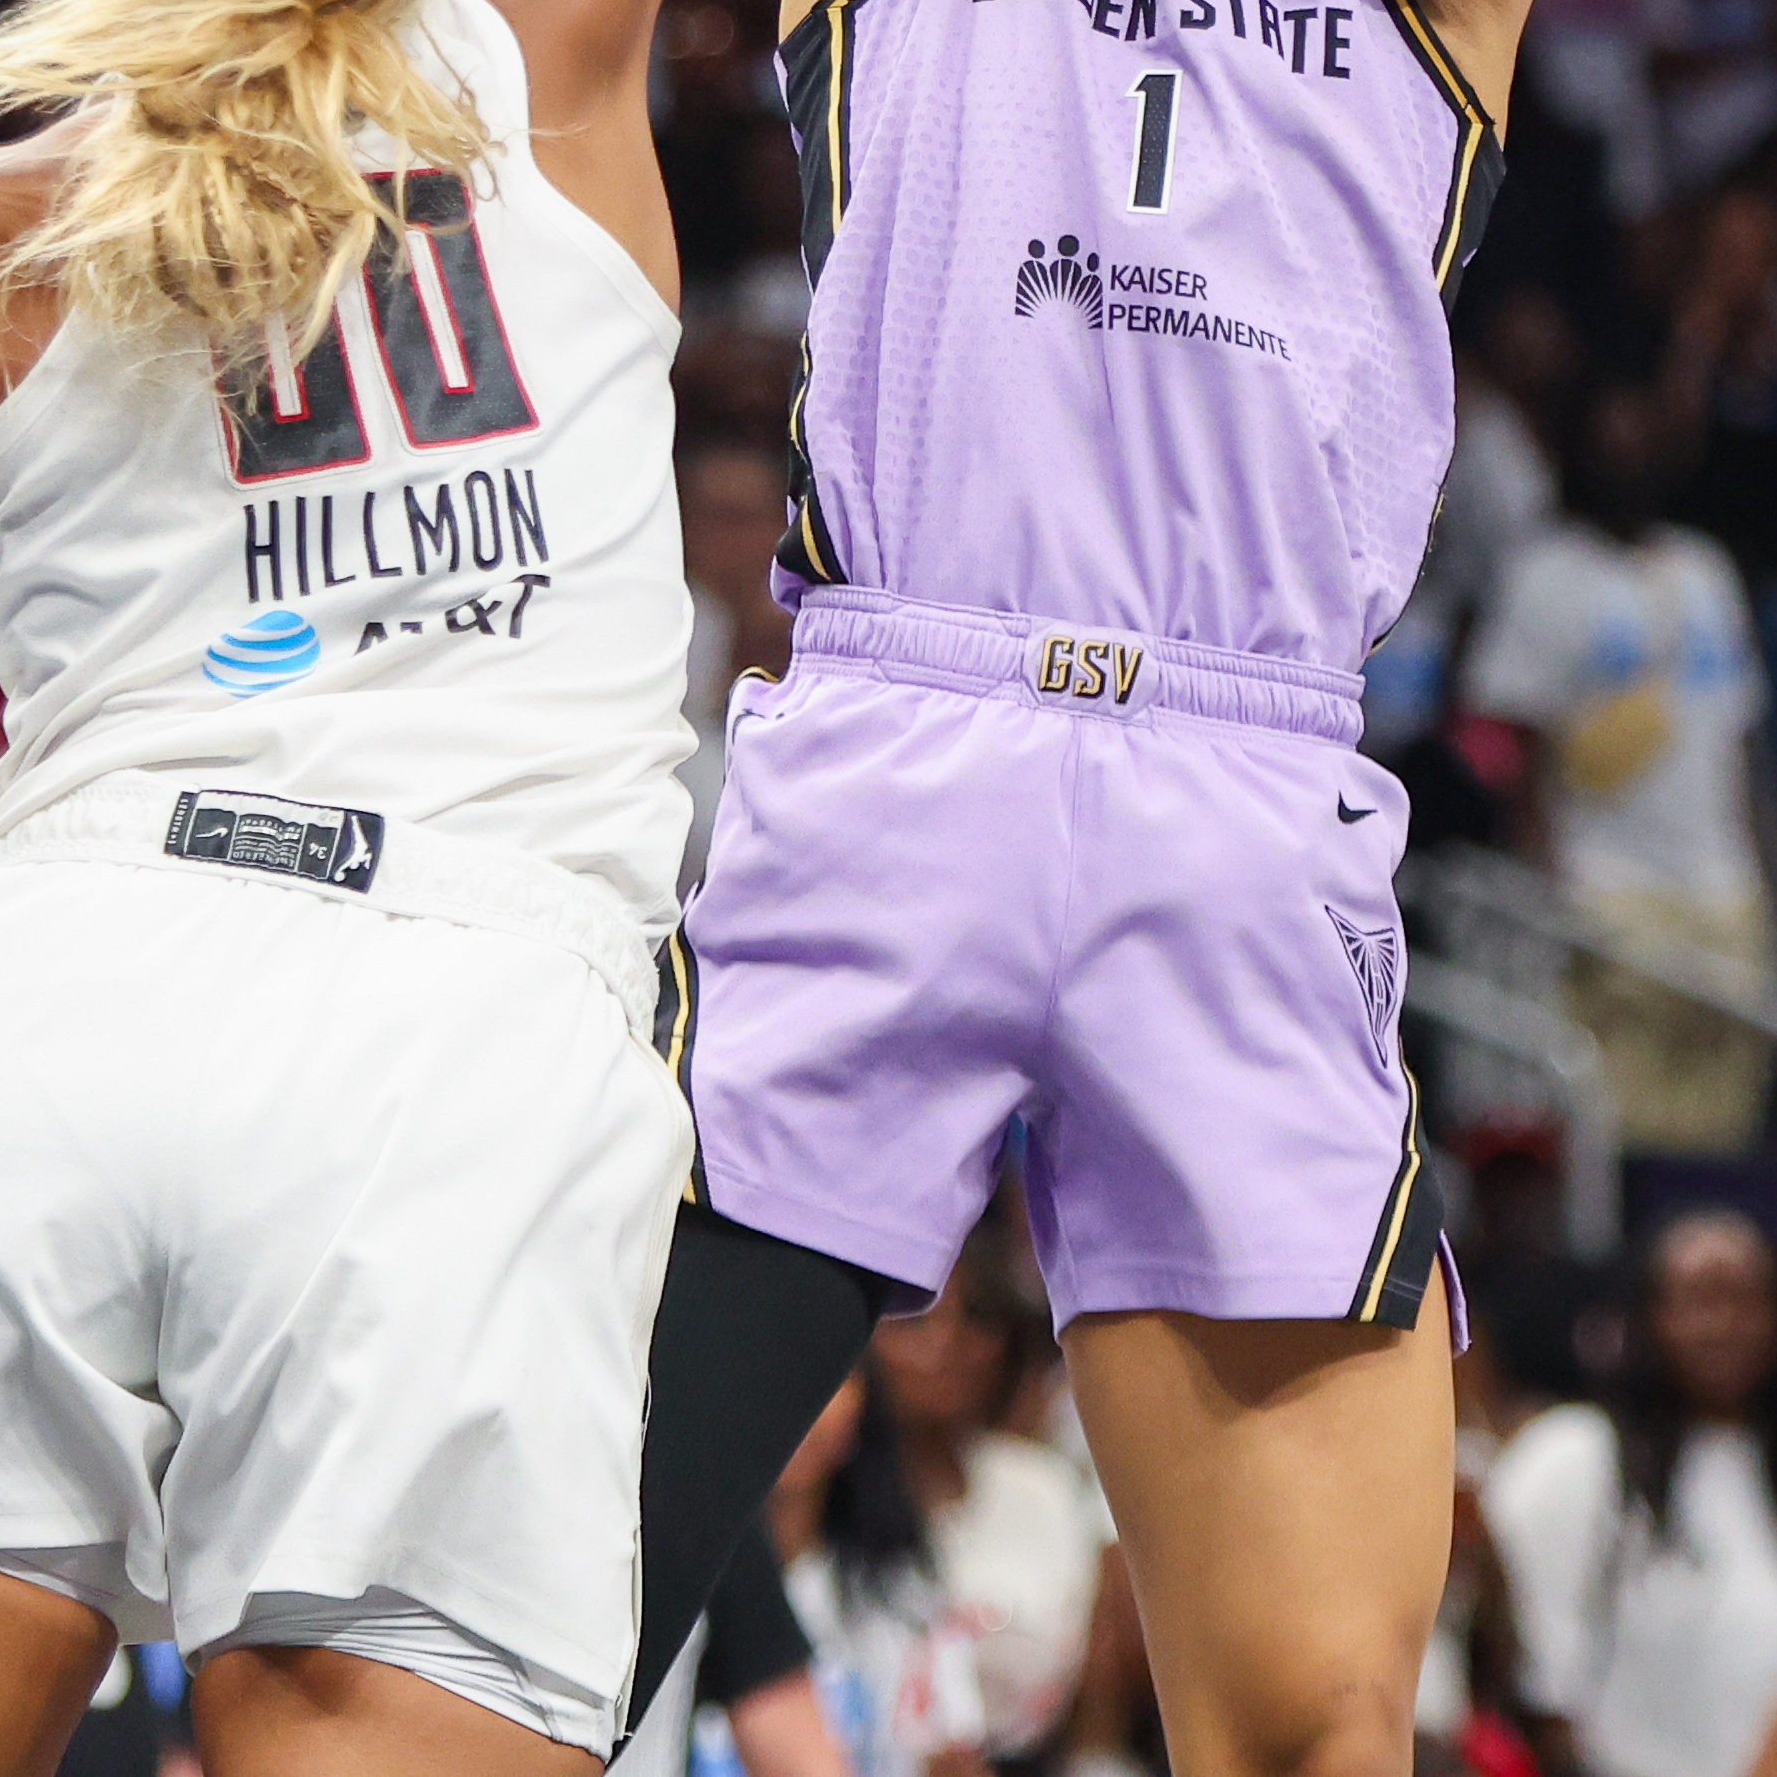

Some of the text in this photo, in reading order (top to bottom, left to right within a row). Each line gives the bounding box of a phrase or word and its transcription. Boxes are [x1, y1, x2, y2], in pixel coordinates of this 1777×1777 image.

[1125, 68, 1183, 215] 1
[1109, 264, 1208, 301] KAISER
[1107, 303, 1292, 362] PERMANENTE
[243, 468, 551, 604] HILLMON
[1037, 634, 1145, 706] GSV
[309, 842, 328, 860] 34
